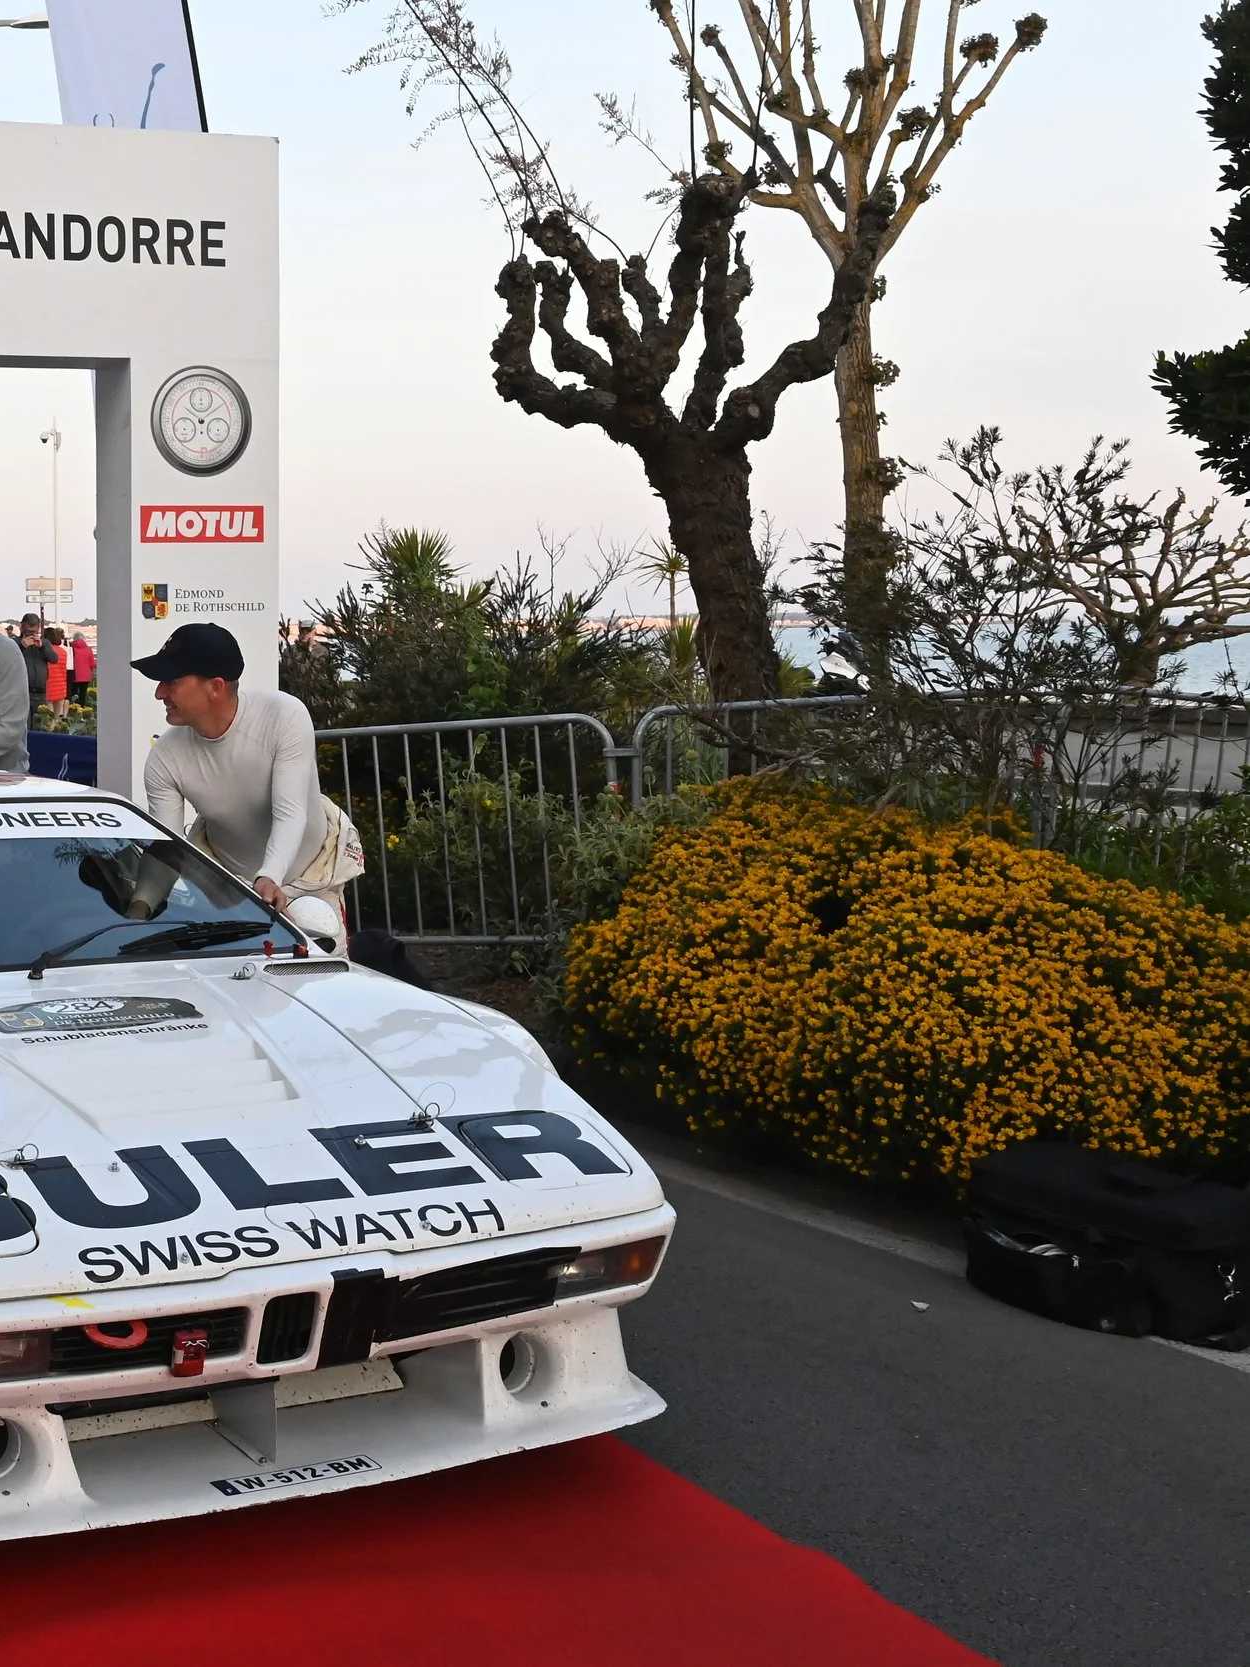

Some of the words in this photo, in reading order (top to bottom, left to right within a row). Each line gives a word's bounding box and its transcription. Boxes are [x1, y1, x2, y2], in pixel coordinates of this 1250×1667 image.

[146, 510, 259, 538] MOTUL
[174, 588, 225, 599] EDMOND
[193, 601, 265, 612] ROTHSCHILD
[56, 1001, 114, 1013] 284
[21, 1022, 209, 1045] Schubladenschränke
[77, 1223, 281, 1283] SWISS
[283, 1197, 505, 1251] WATCH
[234, 1455, 373, 1490] W-512-BM
